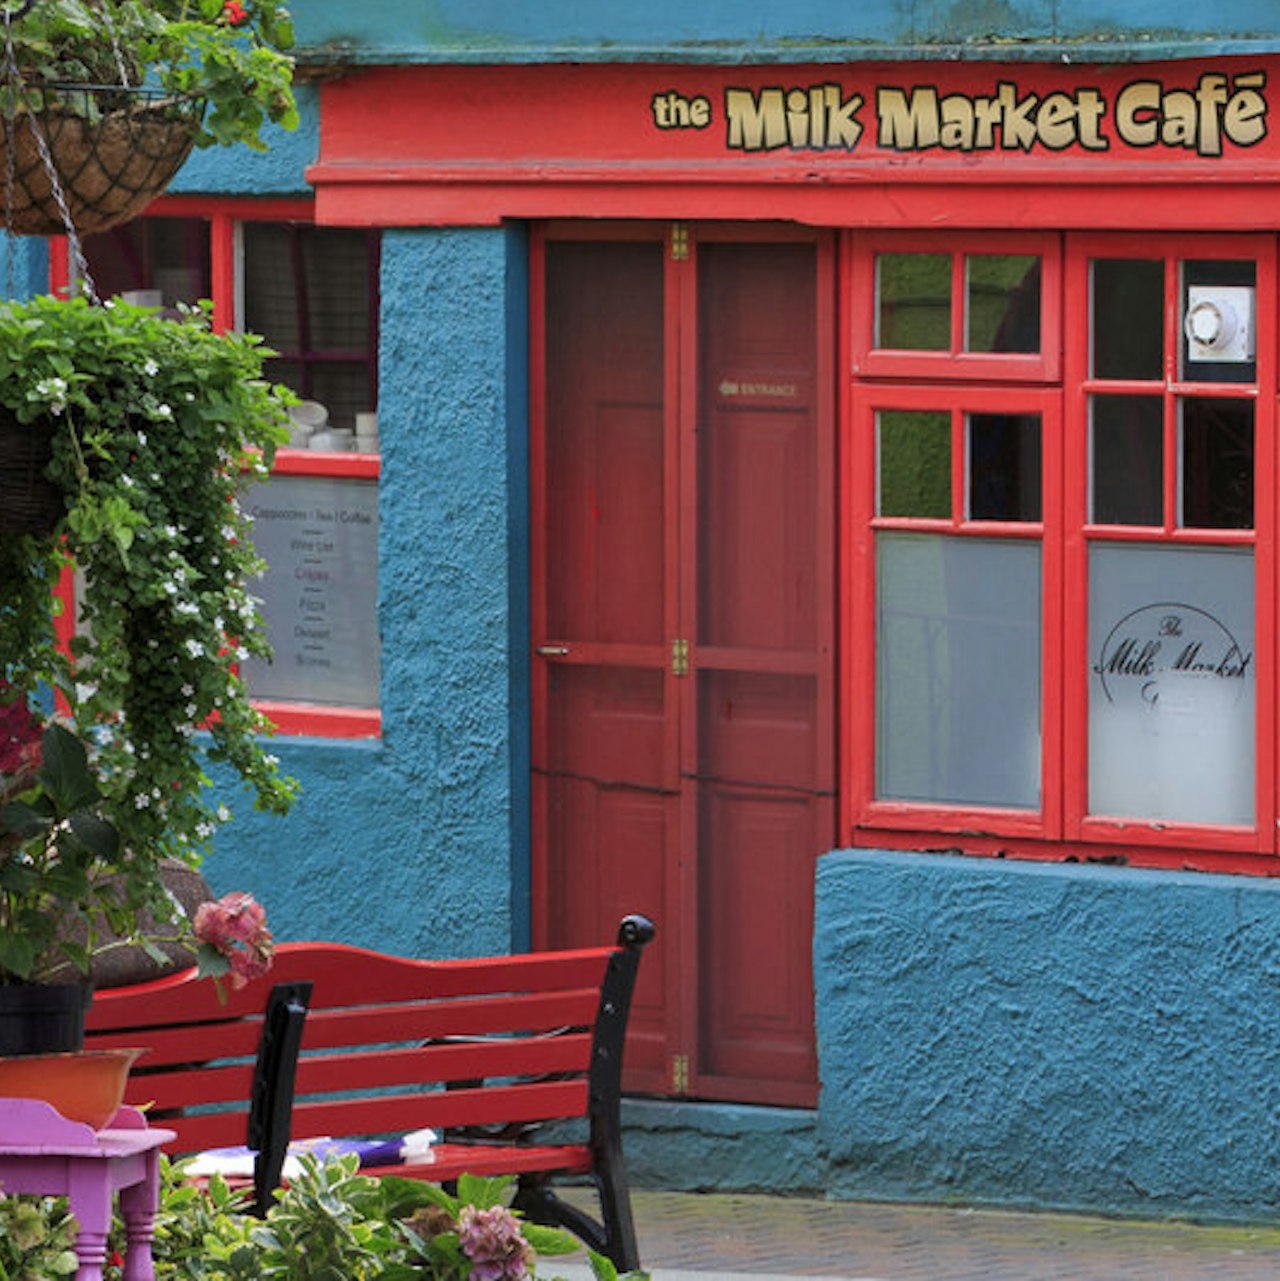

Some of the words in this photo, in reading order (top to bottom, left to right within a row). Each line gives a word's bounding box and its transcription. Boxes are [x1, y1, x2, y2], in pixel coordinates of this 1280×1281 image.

[653, 92, 710, 129] the
[725, 83, 862, 152] Milk
[876, 82, 1108, 153] Market
[1115, 71, 1267, 158] Café
[1093, 637, 1161, 676] Milk
[1170, 641, 1252, 679] Market
